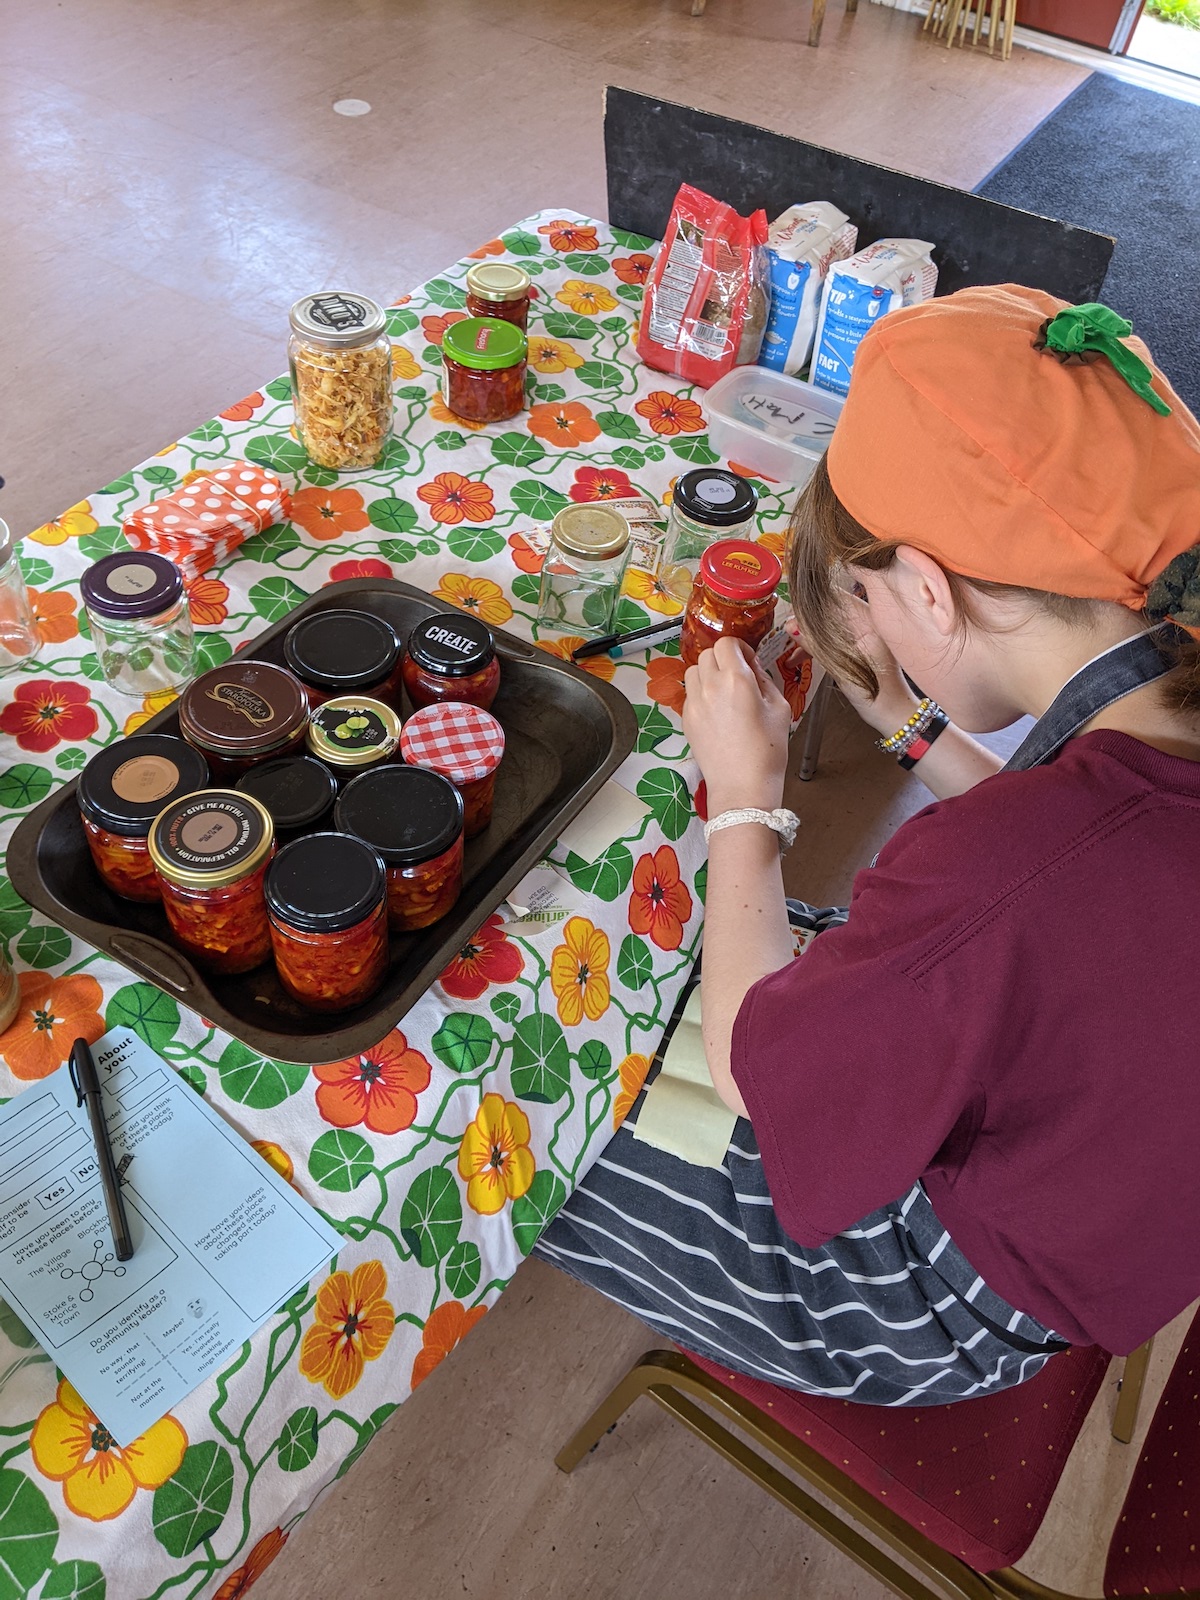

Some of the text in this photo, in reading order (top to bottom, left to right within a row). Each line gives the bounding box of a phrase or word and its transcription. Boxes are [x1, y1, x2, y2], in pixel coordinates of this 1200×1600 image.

[830, 288, 847, 305] TIP
[318, 298, 358, 327] DINO'S
[818, 352, 840, 373] FACT
[721, 560, 733, 568] LEE
[747, 568, 759, 576] KEE
[424, 625, 478, 655] CREATE
[220, 687, 267, 717] STAROPOLSKA
[186, 803, 206, 815] GIVE
[177, 850, 226, 863] SEPARATION
[227, 846, 240, 857] OIL
[98, 1037, 134, 1065] About
[106, 1109, 122, 1123] nder
[119, 1107, 171, 1148] of these places
[128, 1119, 140, 1132] did
[140, 1110, 154, 1124] you
[154, 1097, 172, 1112] think
[126, 1111, 174, 1151] before today?
[78, 1163, 95, 1178] No
[44, 1186, 65, 1202] Yes
[8, 1209, 29, 1225] to be
[12, 1198, 96, 1258] Have you been to any
[194, 1186, 265, 1248] How have your ideas
[203, 1194, 267, 1251] about these places
[216, 1206, 265, 1250] changed since
[16, 1200, 103, 1265] of these places before?
[214, 1203, 277, 1261] taking part today?
[27, 1247, 72, 1279] The Village
[47, 1261, 65, 1276] Hub
[43, 1294, 75, 1319] Stoke &
[49, 1302, 78, 1324] Morice
[57, 1310, 81, 1328] Town
[89, 1336, 102, 1349] Do
[102, 1324, 119, 1340] you
[118, 1302, 150, 1327] identify
[148, 1293, 159, 1304] as
[95, 1295, 168, 1355] community leader?
[162, 1317, 186, 1339] Maybe?
[181, 1344, 193, 1355] Yes
[203, 1321, 220, 1338] really
[190, 1330, 221, 1357] involved in
[200, 1339, 223, 1360] making
[99, 1364, 110, 1376] No
[110, 1354, 124, 1369] way
[126, 1342, 141, 1355] that
[113, 1356, 137, 1376] sounds
[197, 1338, 236, 1374] things happen
[115, 1358, 147, 1386] terrifying!
[130, 1377, 162, 1404] Not at the
[139, 1385, 166, 1409] moment
